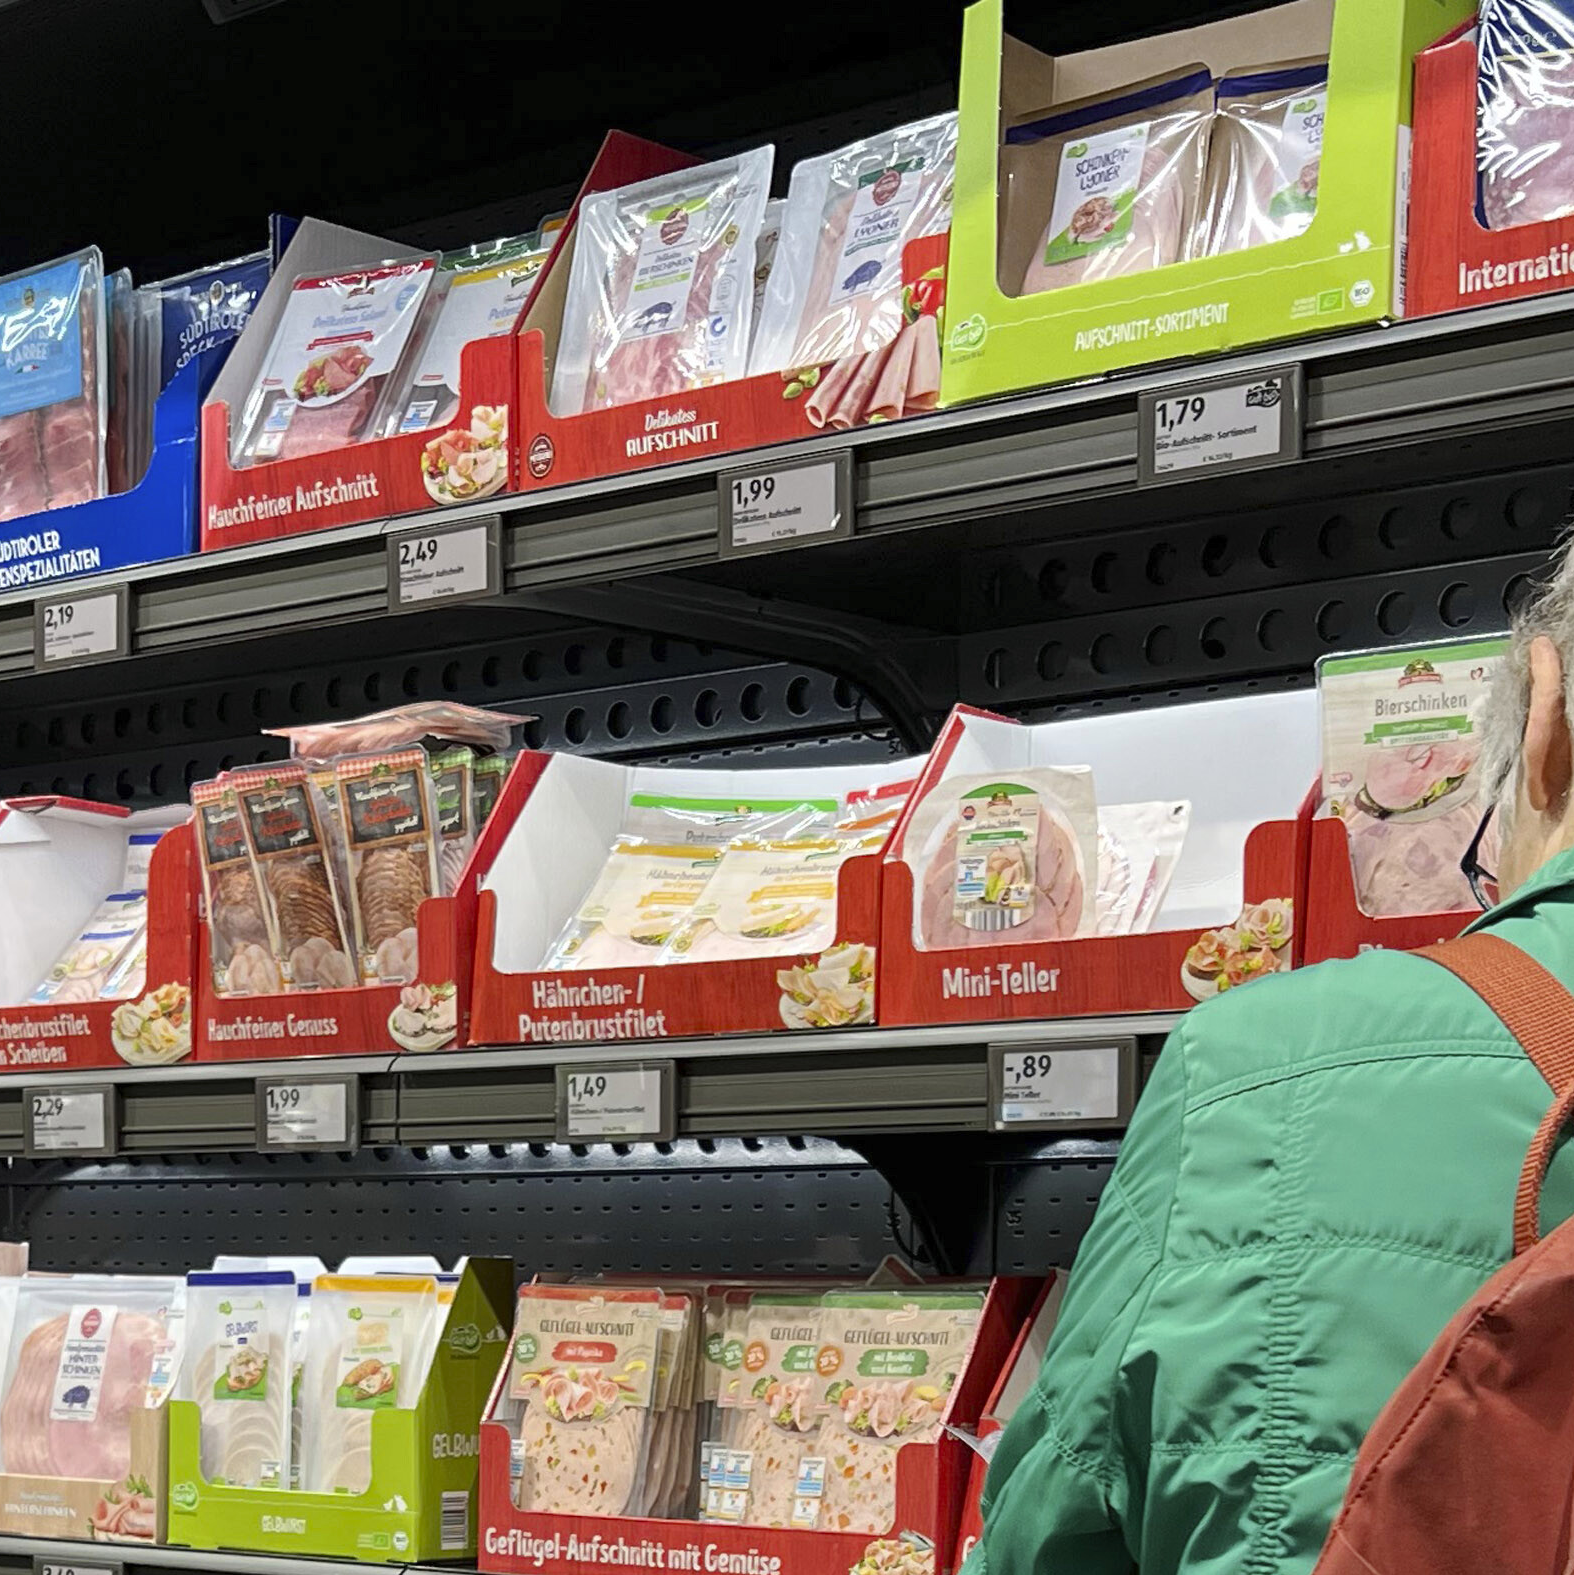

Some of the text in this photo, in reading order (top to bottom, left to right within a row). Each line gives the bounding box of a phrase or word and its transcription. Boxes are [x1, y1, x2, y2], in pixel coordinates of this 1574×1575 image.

[1080, 164, 1121, 191] LYONER
[855, 221, 898, 239] LYONER
[1074, 303, 1230, 353] AUFSCHNITT-SORTIMENT
[644, 408, 697, 433] Delikatess
[1156, 396, 1205, 431] 1,79
[625, 421, 719, 458] AUFSCHNITT
[207, 471, 379, 531] Hauchfeiner Aufschnitt
[732, 476, 776, 508] 1,99
[399, 538, 438, 568] 2,49
[44, 604, 74, 630] 2,19
[1374, 690, 1468, 718] Bierschinken
[531, 976, 633, 1010] Hähnchen-
[942, 961, 1061, 1000] Mini-Teller
[207, 1013, 339, 1041] Hauchfeiner Genuss
[518, 1008, 669, 1043] Putenbrustfilet
[7, 1040, 68, 1065] Scheiben
[1005, 1053, 1052, 1084] -,89
[266, 1087, 300, 1110] 1,99
[568, 1075, 607, 1101] 1,49
[33, 1097, 65, 1121] 2,29
[539, 1319, 635, 1337] GEFLÜGEL-AUFSCHNITT
[770, 1326, 824, 1342] GEFLÜGEL-
[844, 1330, 950, 1347] GEFLÜGEL-AUFSCHNITT
[484, 1527, 665, 1570] Geflügel-Aufschnitt
[667, 1538, 702, 1571] mit
